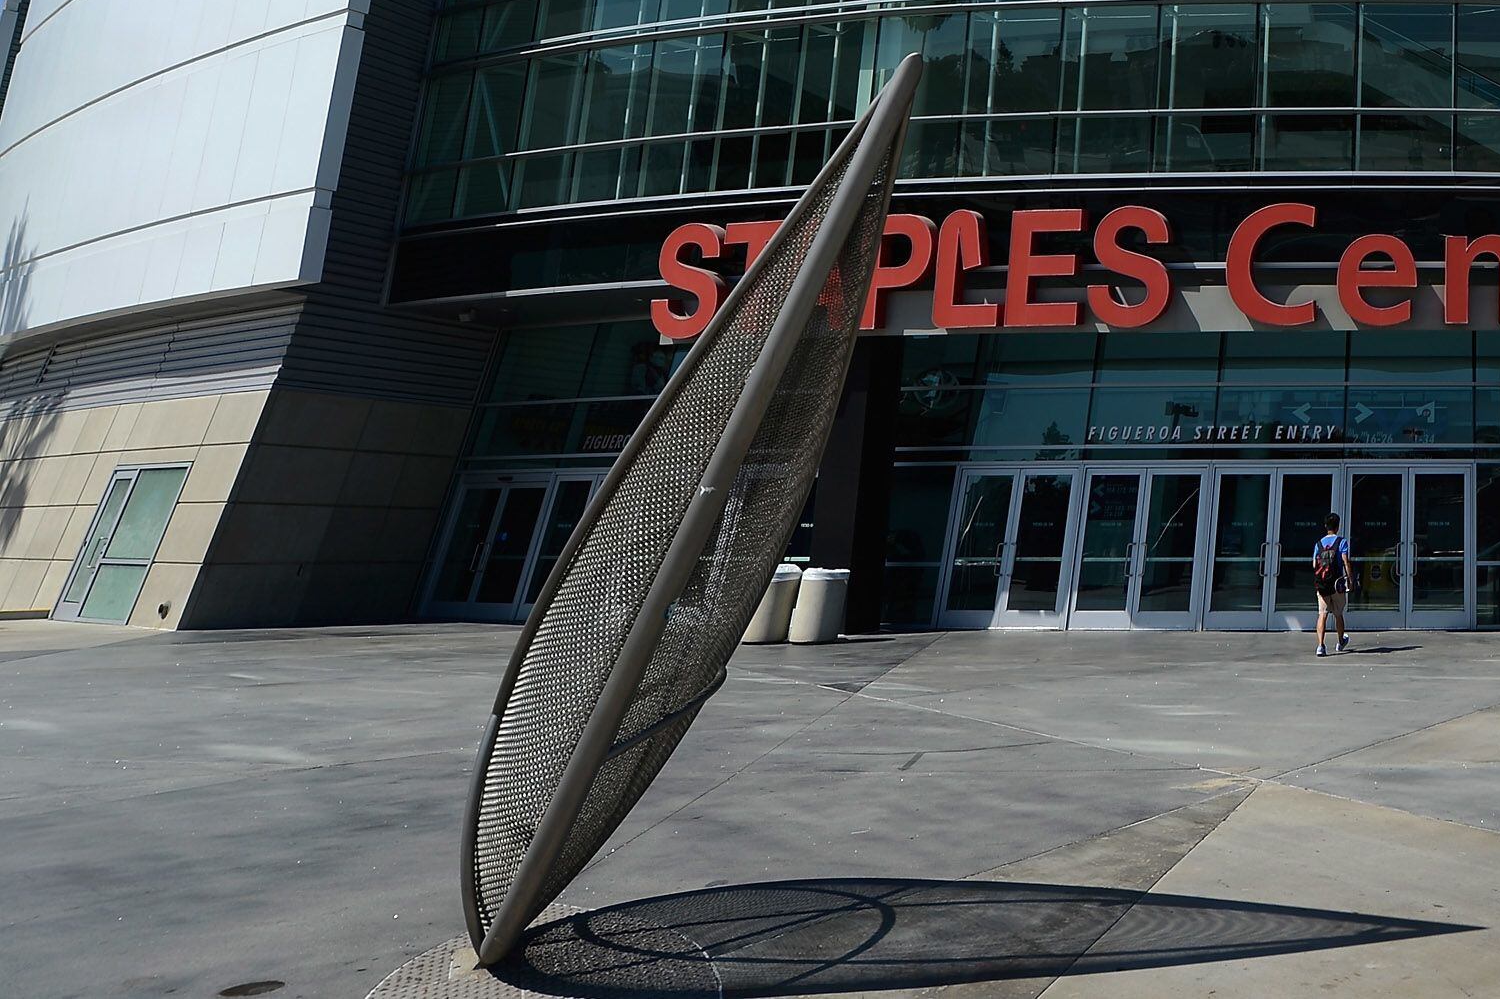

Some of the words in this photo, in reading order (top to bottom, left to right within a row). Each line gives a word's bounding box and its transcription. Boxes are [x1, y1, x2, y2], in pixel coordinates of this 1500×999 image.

[1087, 425, 1182, 441] FIGUEROA
[1193, 424, 1263, 440] STREET
[1274, 424, 1337, 440] ENTRY
[582, 434, 630, 450] FIGUER
